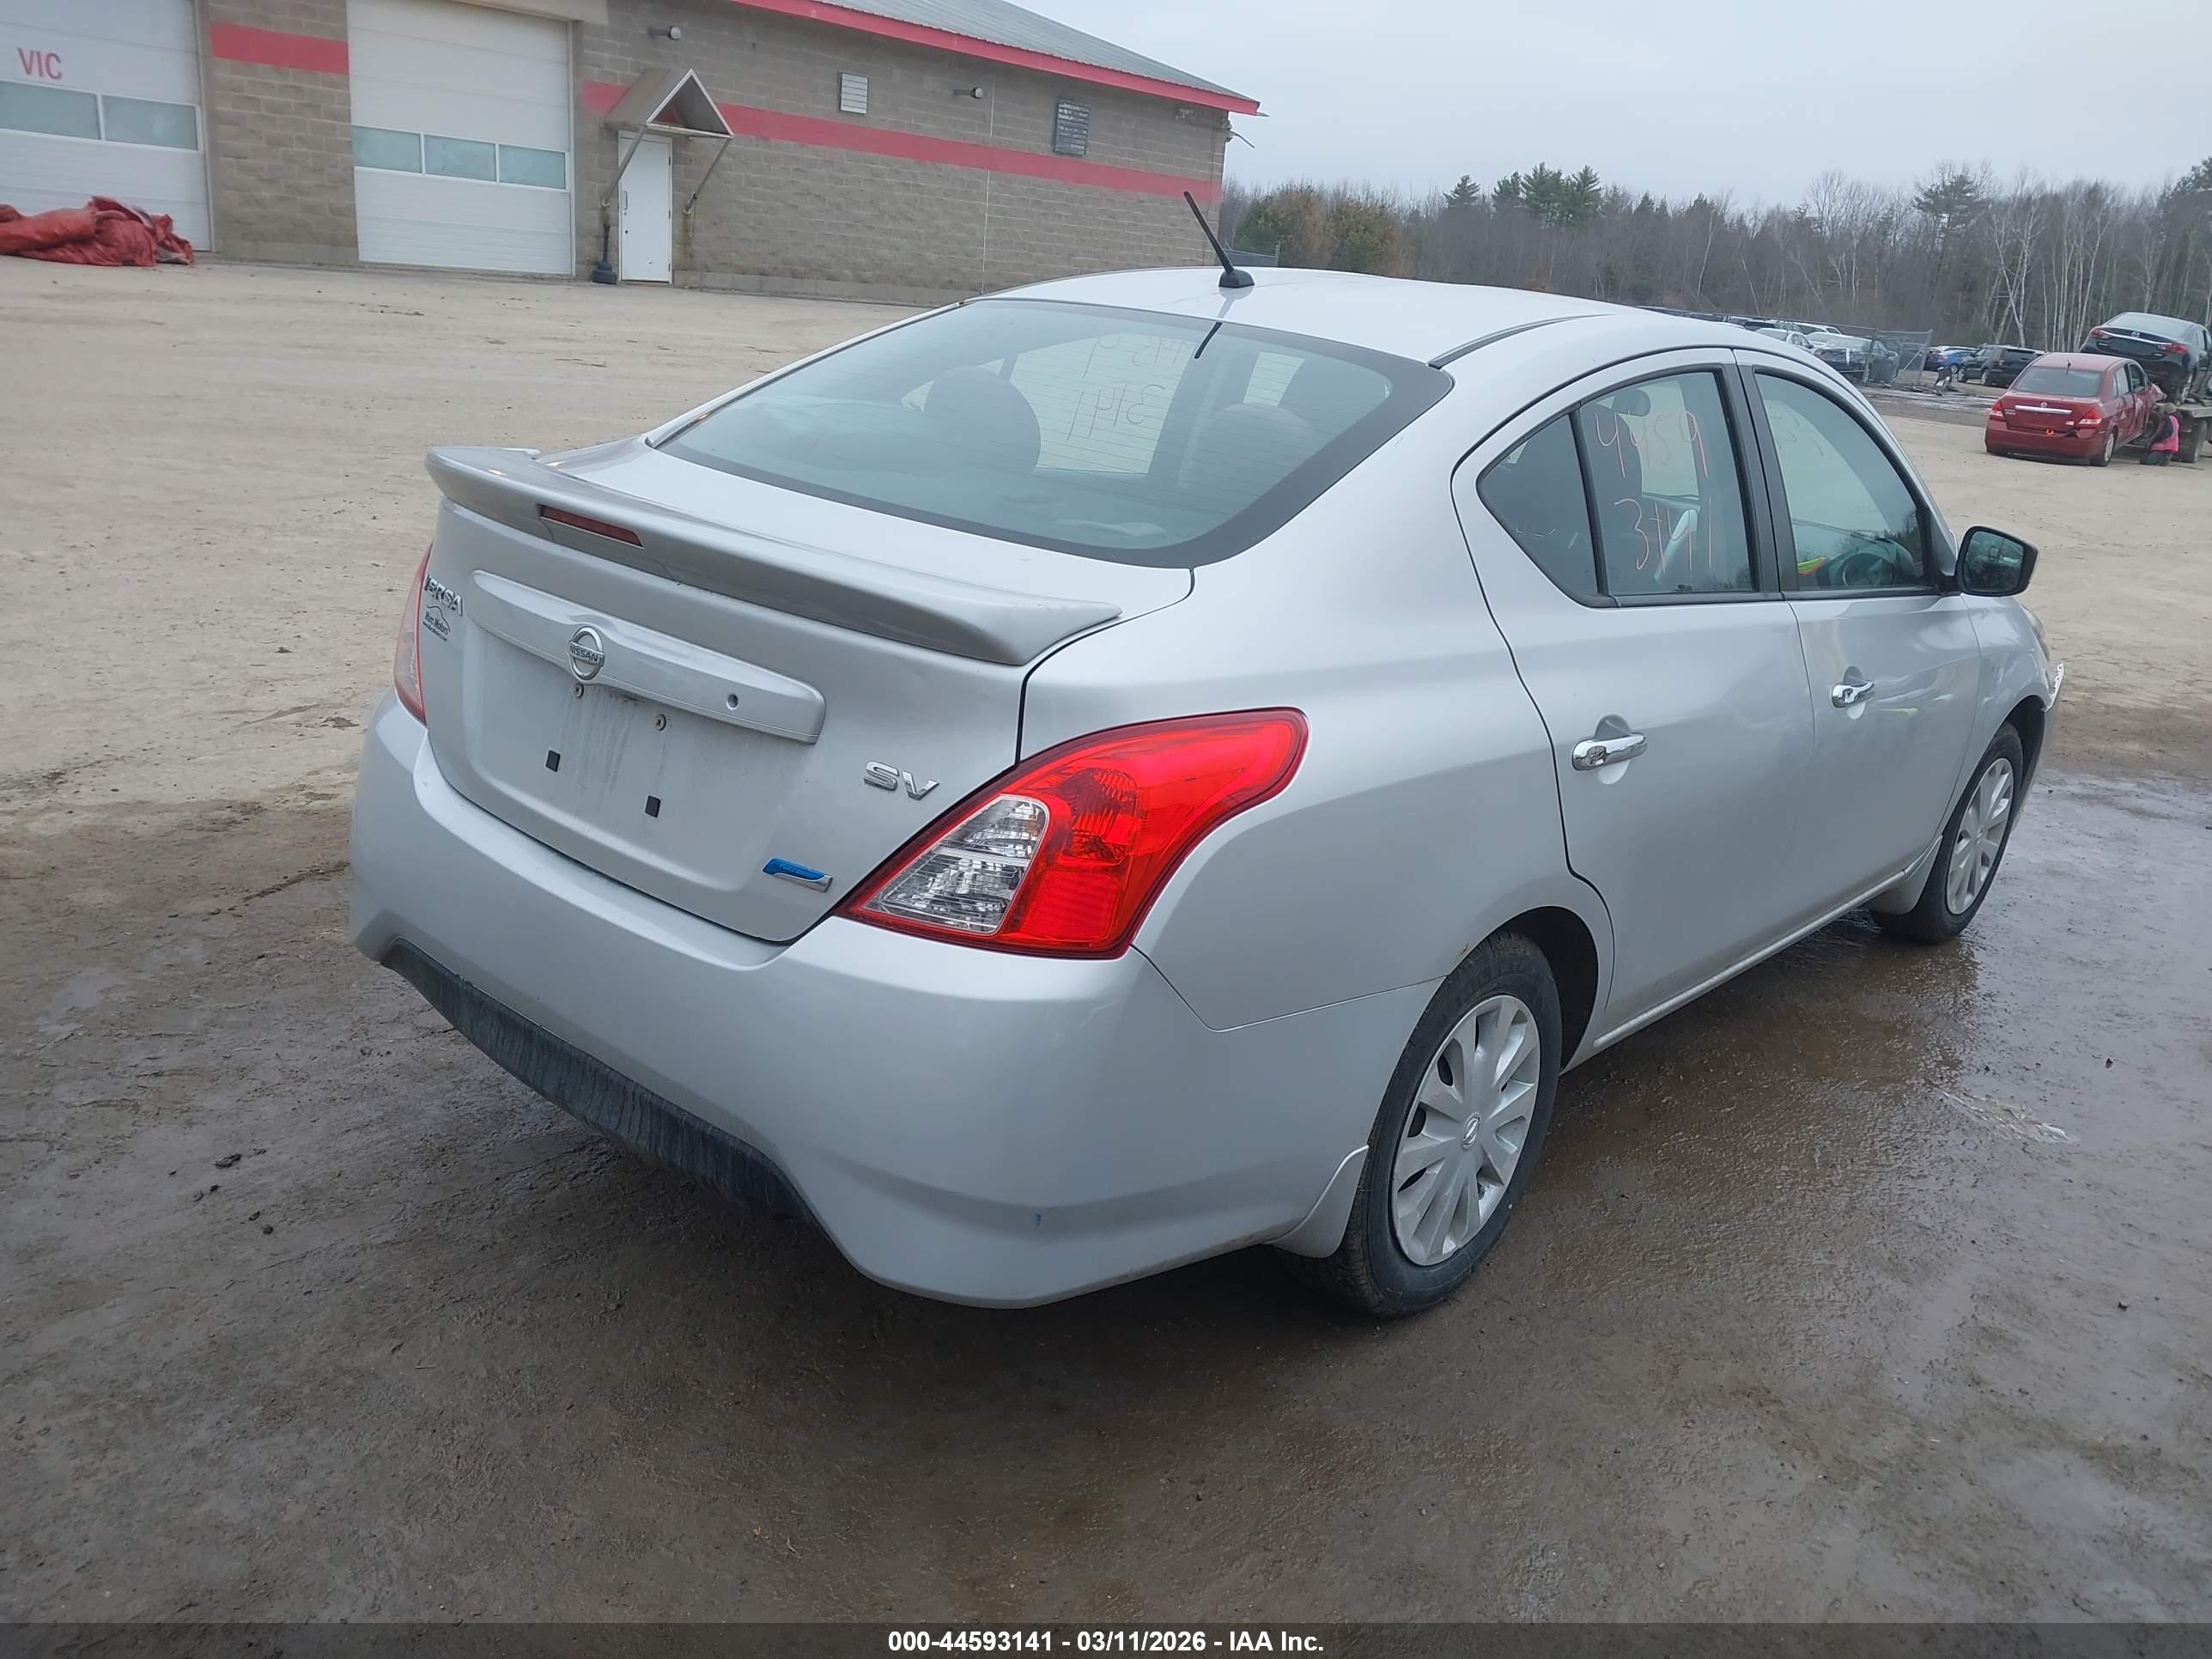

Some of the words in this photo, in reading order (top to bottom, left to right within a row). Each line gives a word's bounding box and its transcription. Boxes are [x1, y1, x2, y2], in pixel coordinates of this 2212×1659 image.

[17, 47, 62, 80] VIC
[569, 645, 599, 662] NISSAN
[863, 761, 940, 800] SV
